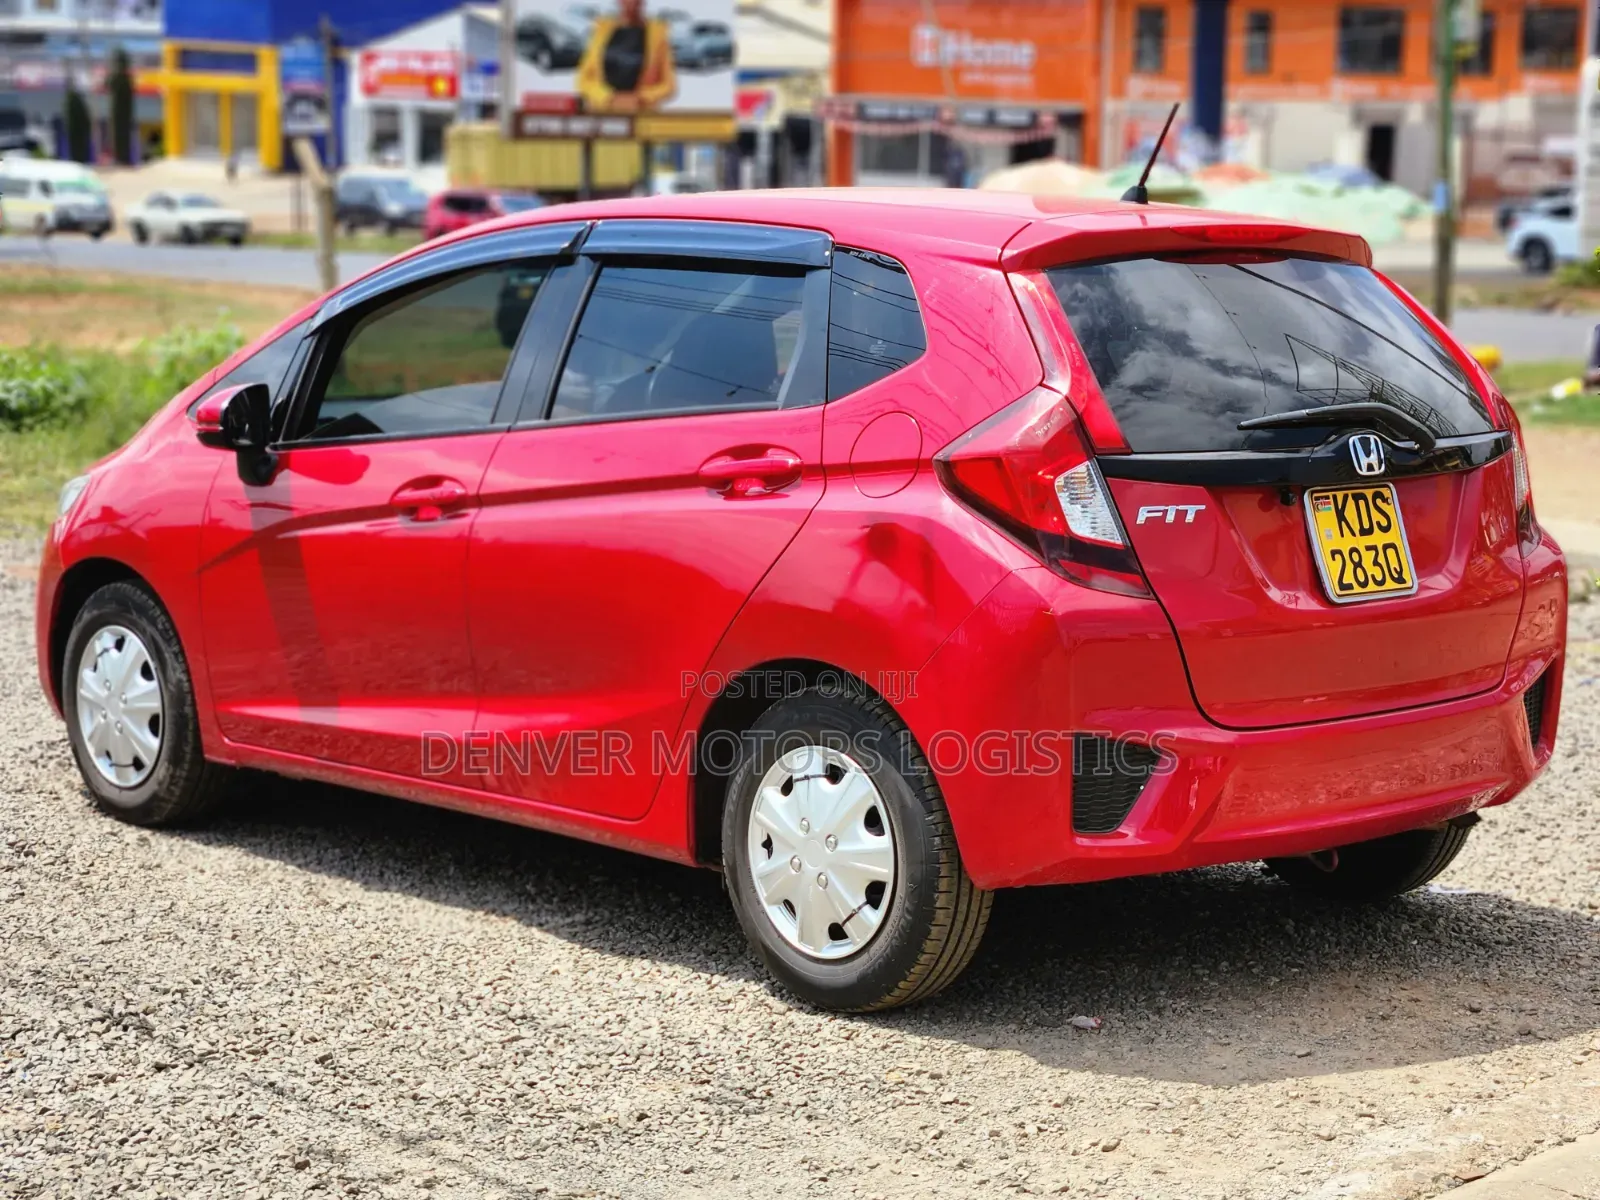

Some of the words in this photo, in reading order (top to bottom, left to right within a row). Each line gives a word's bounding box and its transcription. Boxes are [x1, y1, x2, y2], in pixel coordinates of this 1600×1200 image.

[1136, 505, 1206, 524] FIT
[1332, 490, 1392, 538] KDS
[1330, 542, 1406, 591] 283Q
